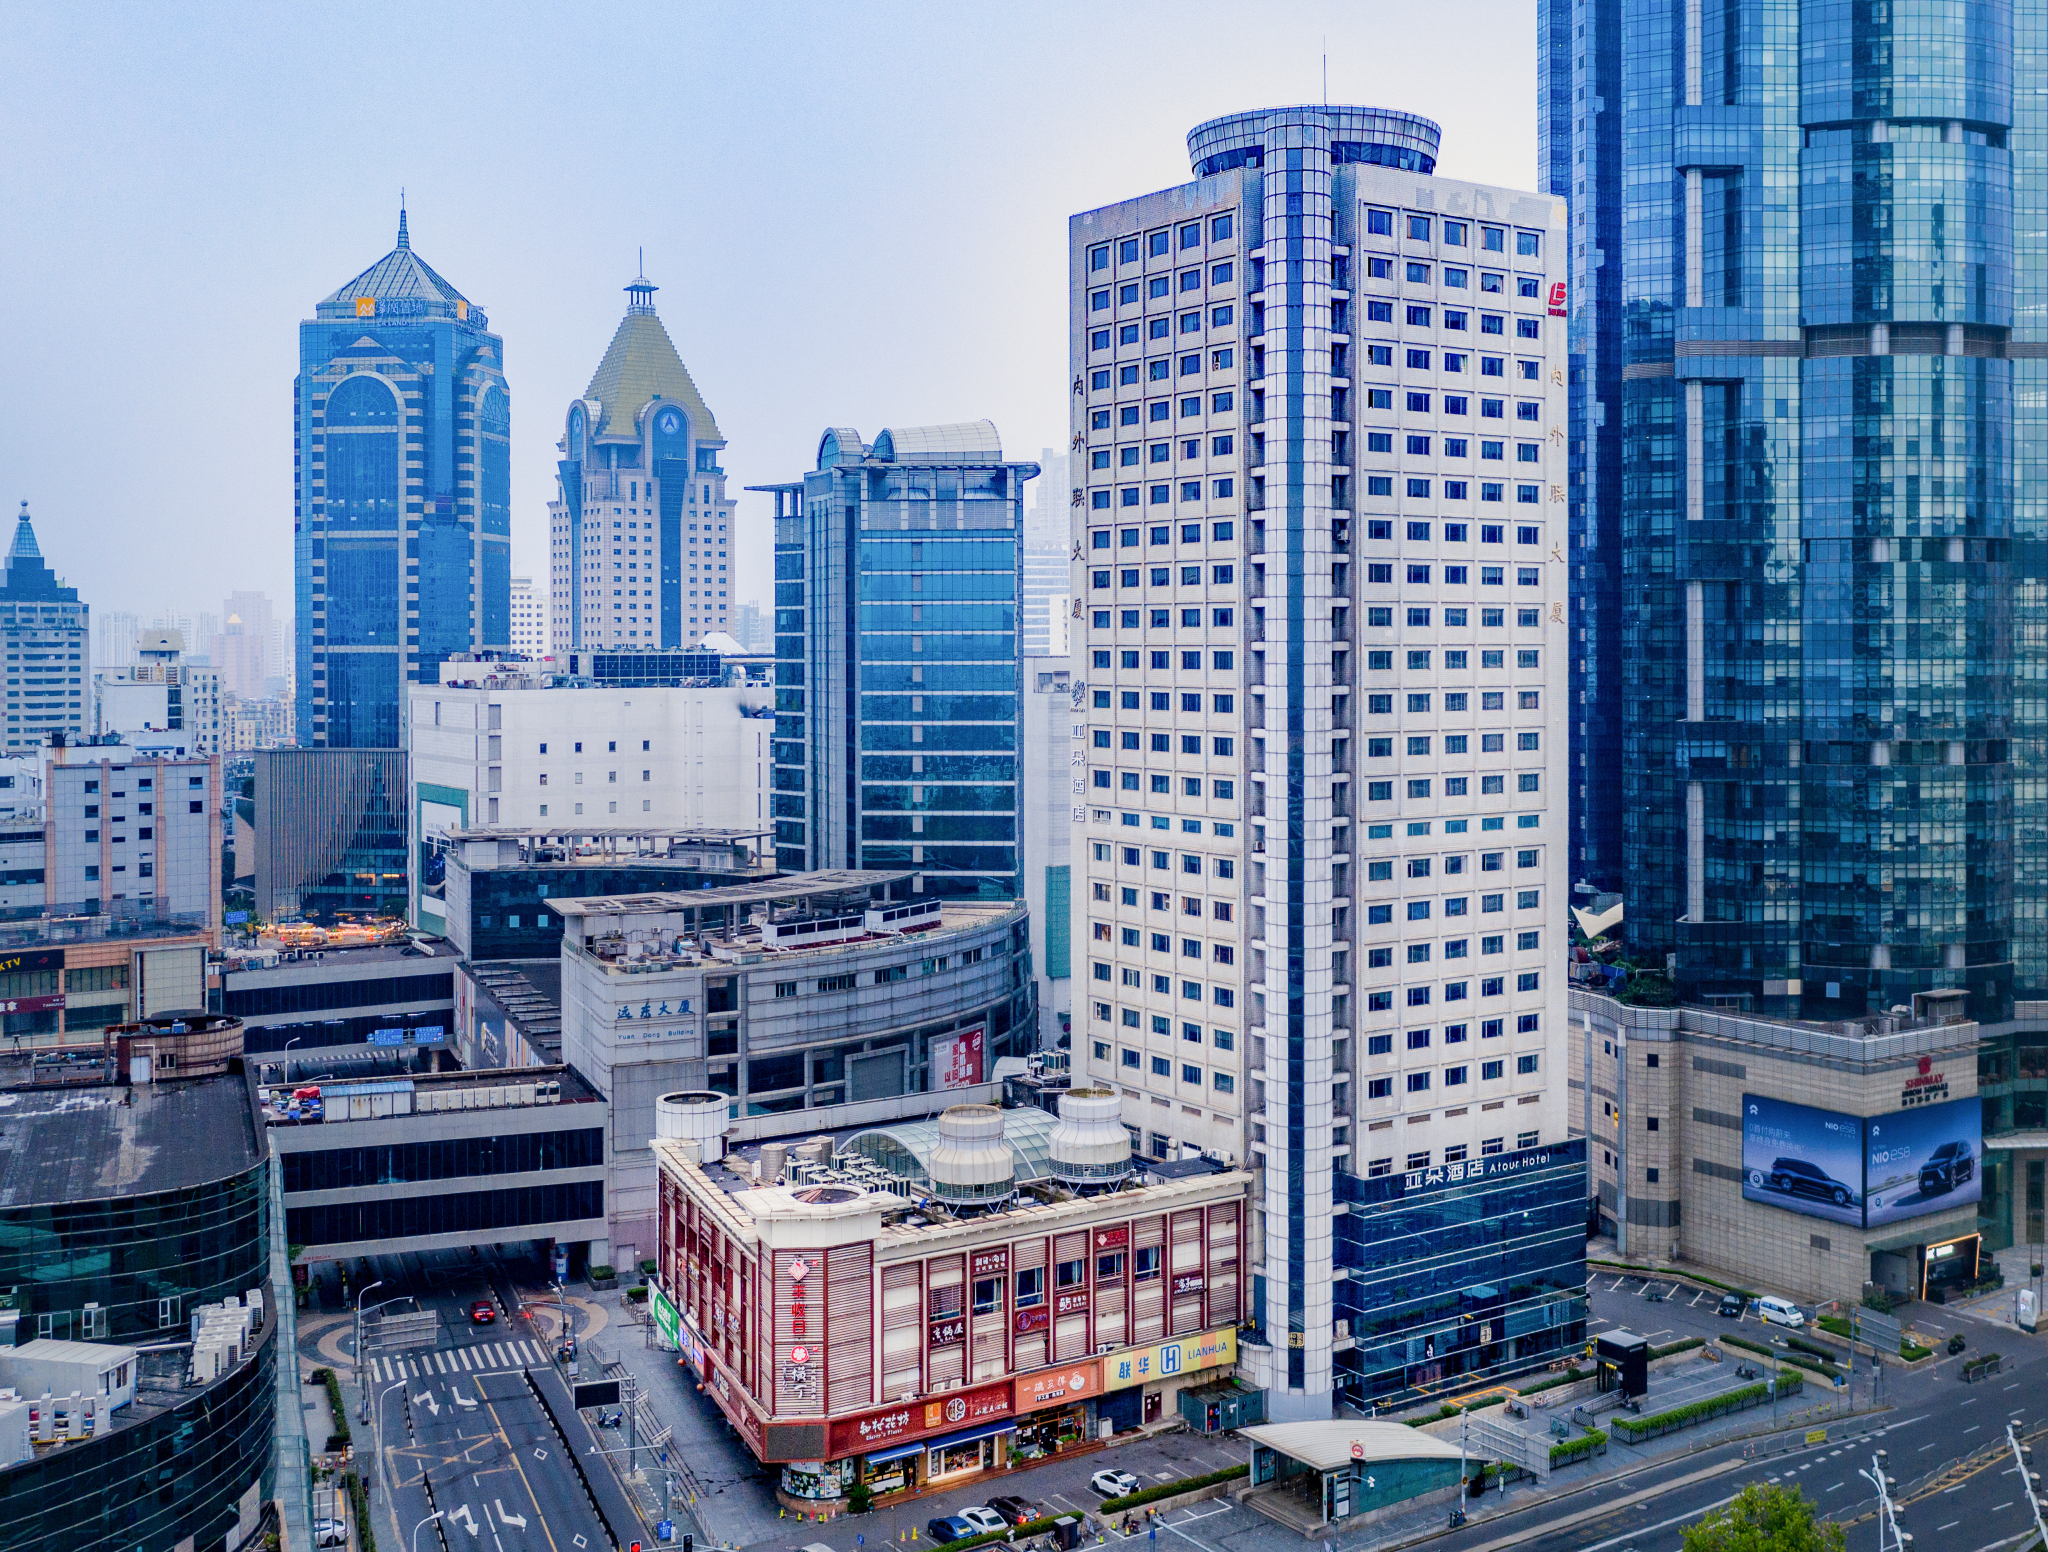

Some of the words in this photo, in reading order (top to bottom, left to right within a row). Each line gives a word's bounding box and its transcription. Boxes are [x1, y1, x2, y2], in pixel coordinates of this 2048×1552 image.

[1549, 363, 1566, 625] 内外联大厦
[1071, 723, 1086, 823] 亚朵酒店
[617, 1000, 694, 1019] 远东大厦
[668, 1029, 694, 1037] Building
[1825, 1121, 1839, 1131] NIO
[1489, 1160, 1519, 1174] Atour
[1522, 1152, 1550, 1167] Hotel
[1872, 1151, 1889, 1165] NIO
[1404, 1160, 1484, 1190] 亚朵酒店
[791, 1284, 806, 1334] 丰收日
[1188, 1342, 1227, 1359] LIANHUA
[1118, 1356, 1150, 1379] 联华
